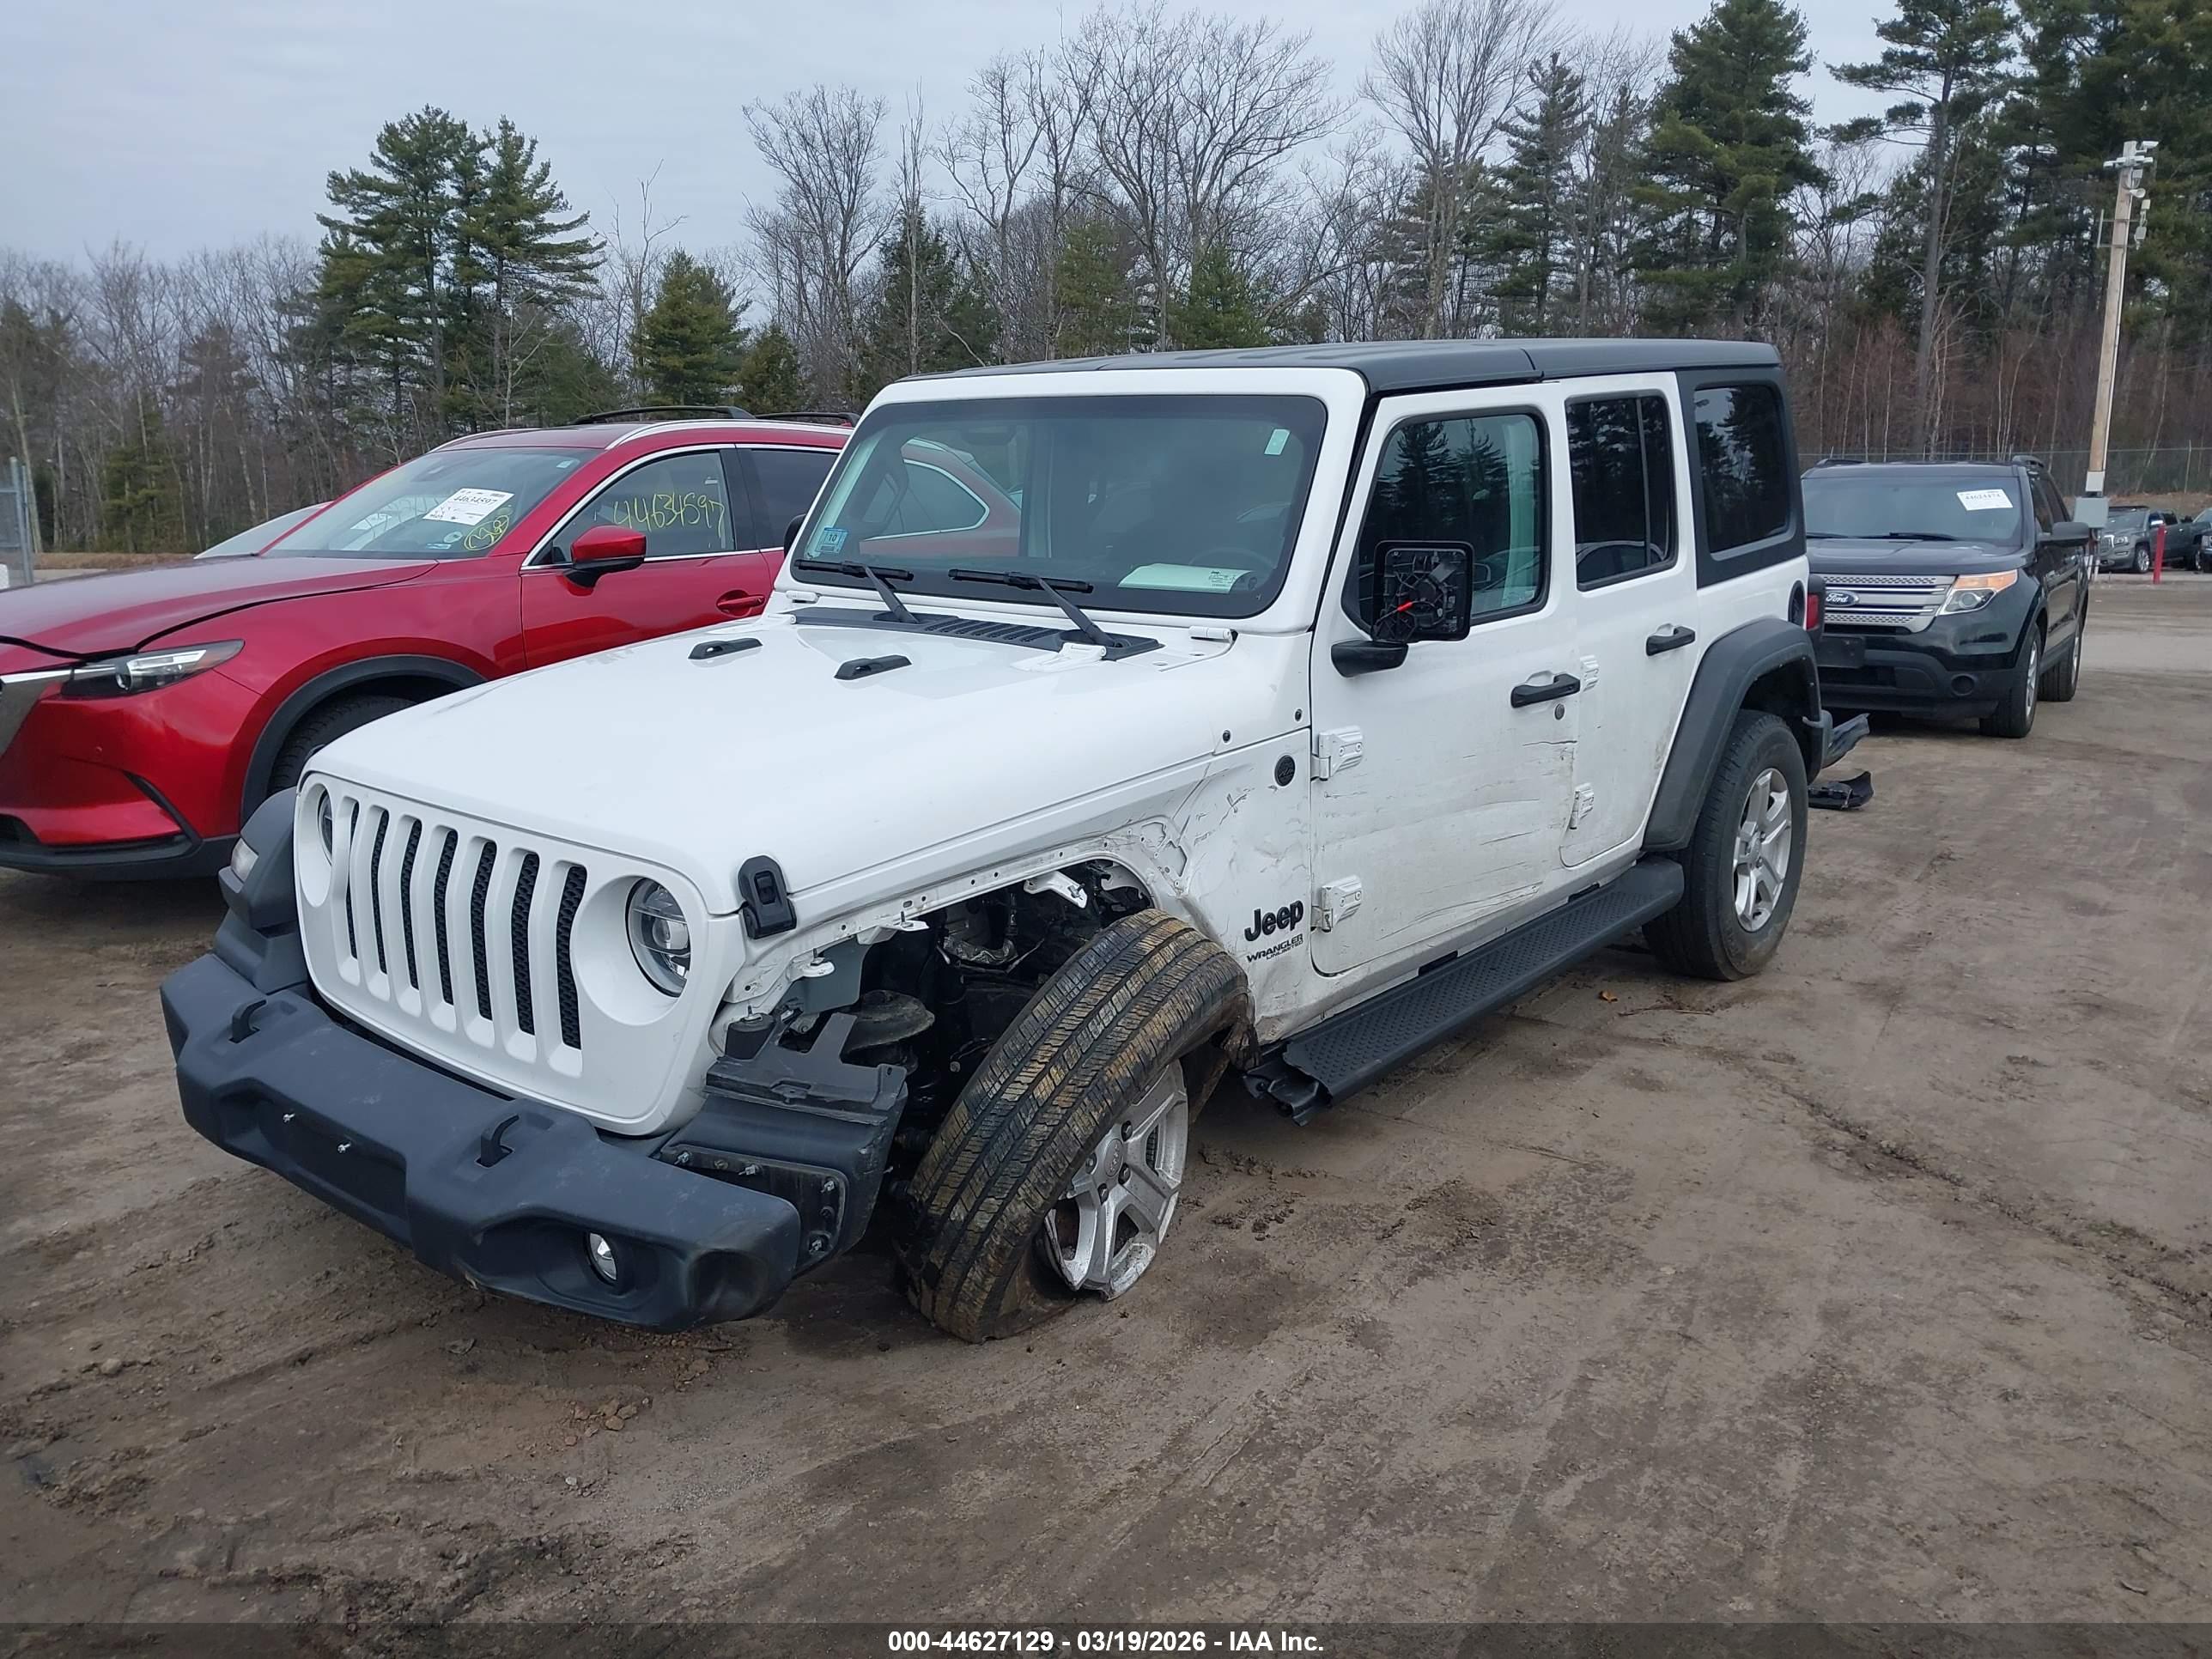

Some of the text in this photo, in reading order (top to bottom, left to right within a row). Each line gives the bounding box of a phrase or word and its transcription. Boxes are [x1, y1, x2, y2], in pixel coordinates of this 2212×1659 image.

[613, 491, 726, 538] 44634597
[828, 533, 838, 543] 10
[1826, 592, 1849, 603] Ford
[1244, 900, 1304, 942] Jeep
[1246, 933, 1304, 963] WRANGLER
[1266, 939, 1304, 960] UNLIMITED
